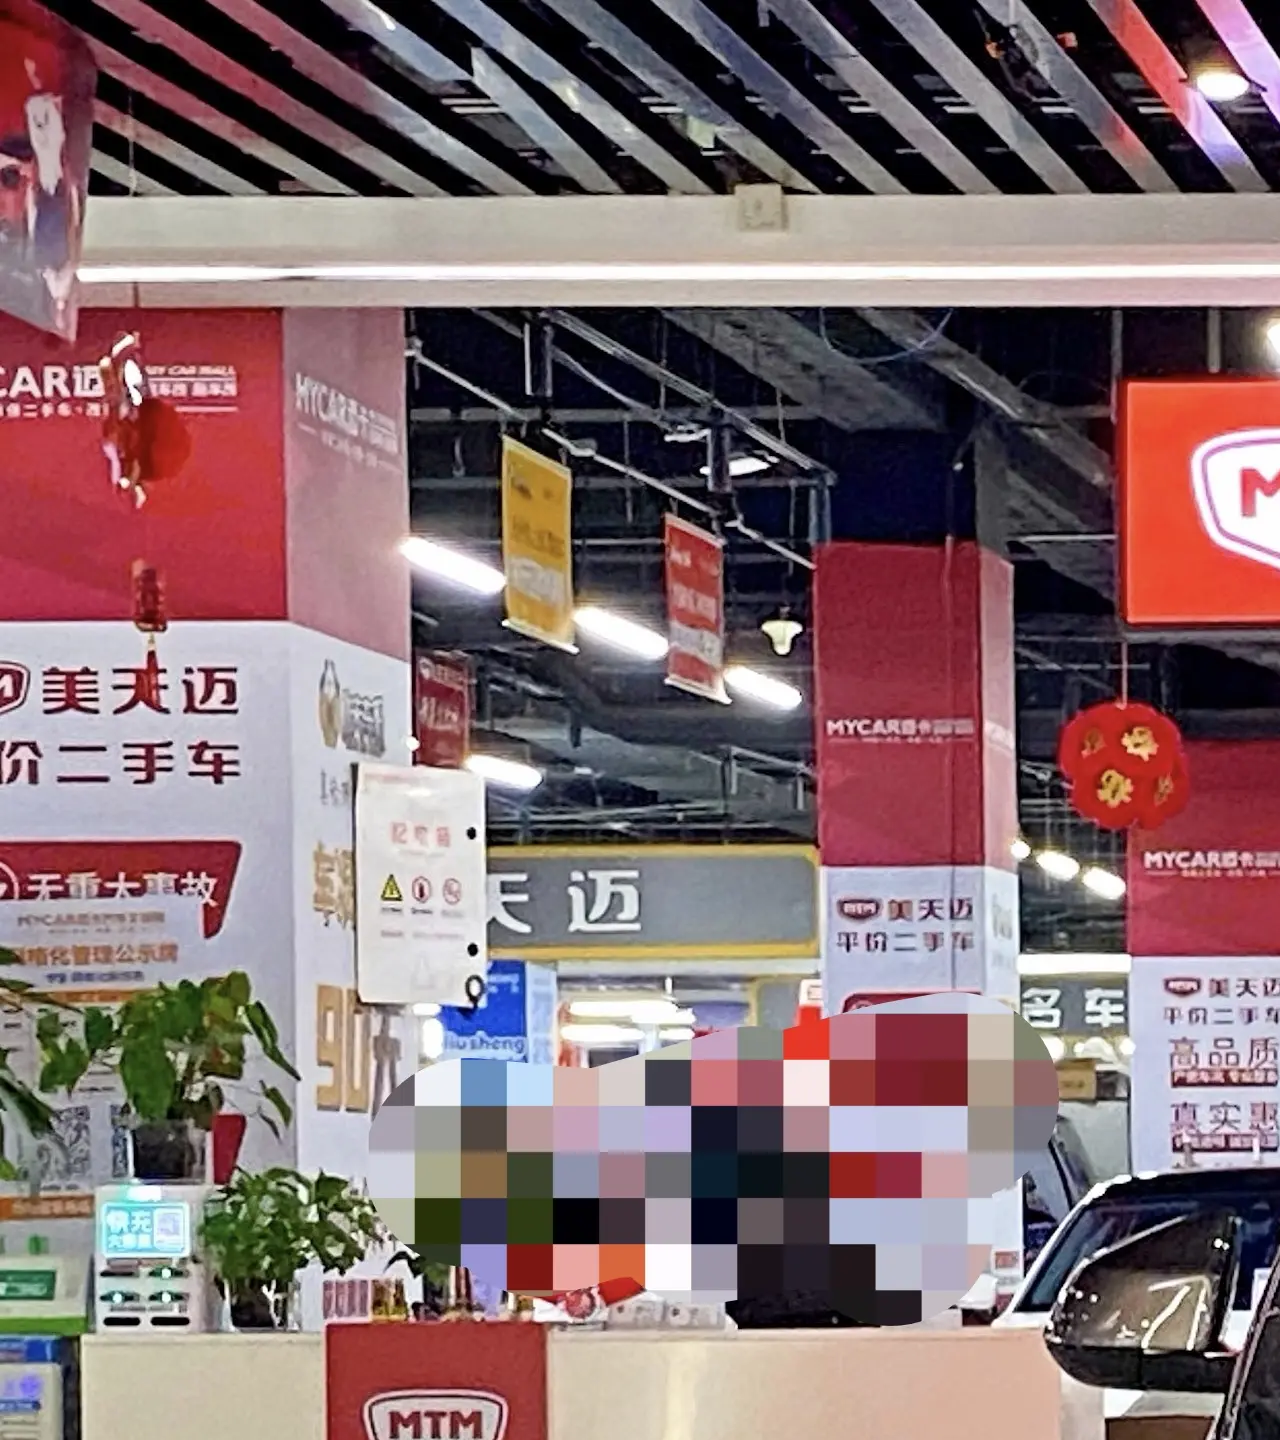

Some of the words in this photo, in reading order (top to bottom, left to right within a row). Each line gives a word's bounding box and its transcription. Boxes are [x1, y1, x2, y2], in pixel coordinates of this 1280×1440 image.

[42, 665, 240, 716] 美天迈
[27, 871, 218, 908] 无重大事故
[887, 897, 975, 922] 美天迈
[837, 931, 975, 952] 平价二手车
[1021, 986, 1125, 1028] 名车
[1168, 1036, 1280, 1069] 高品质
[388, 1411, 483, 1440] MTM
